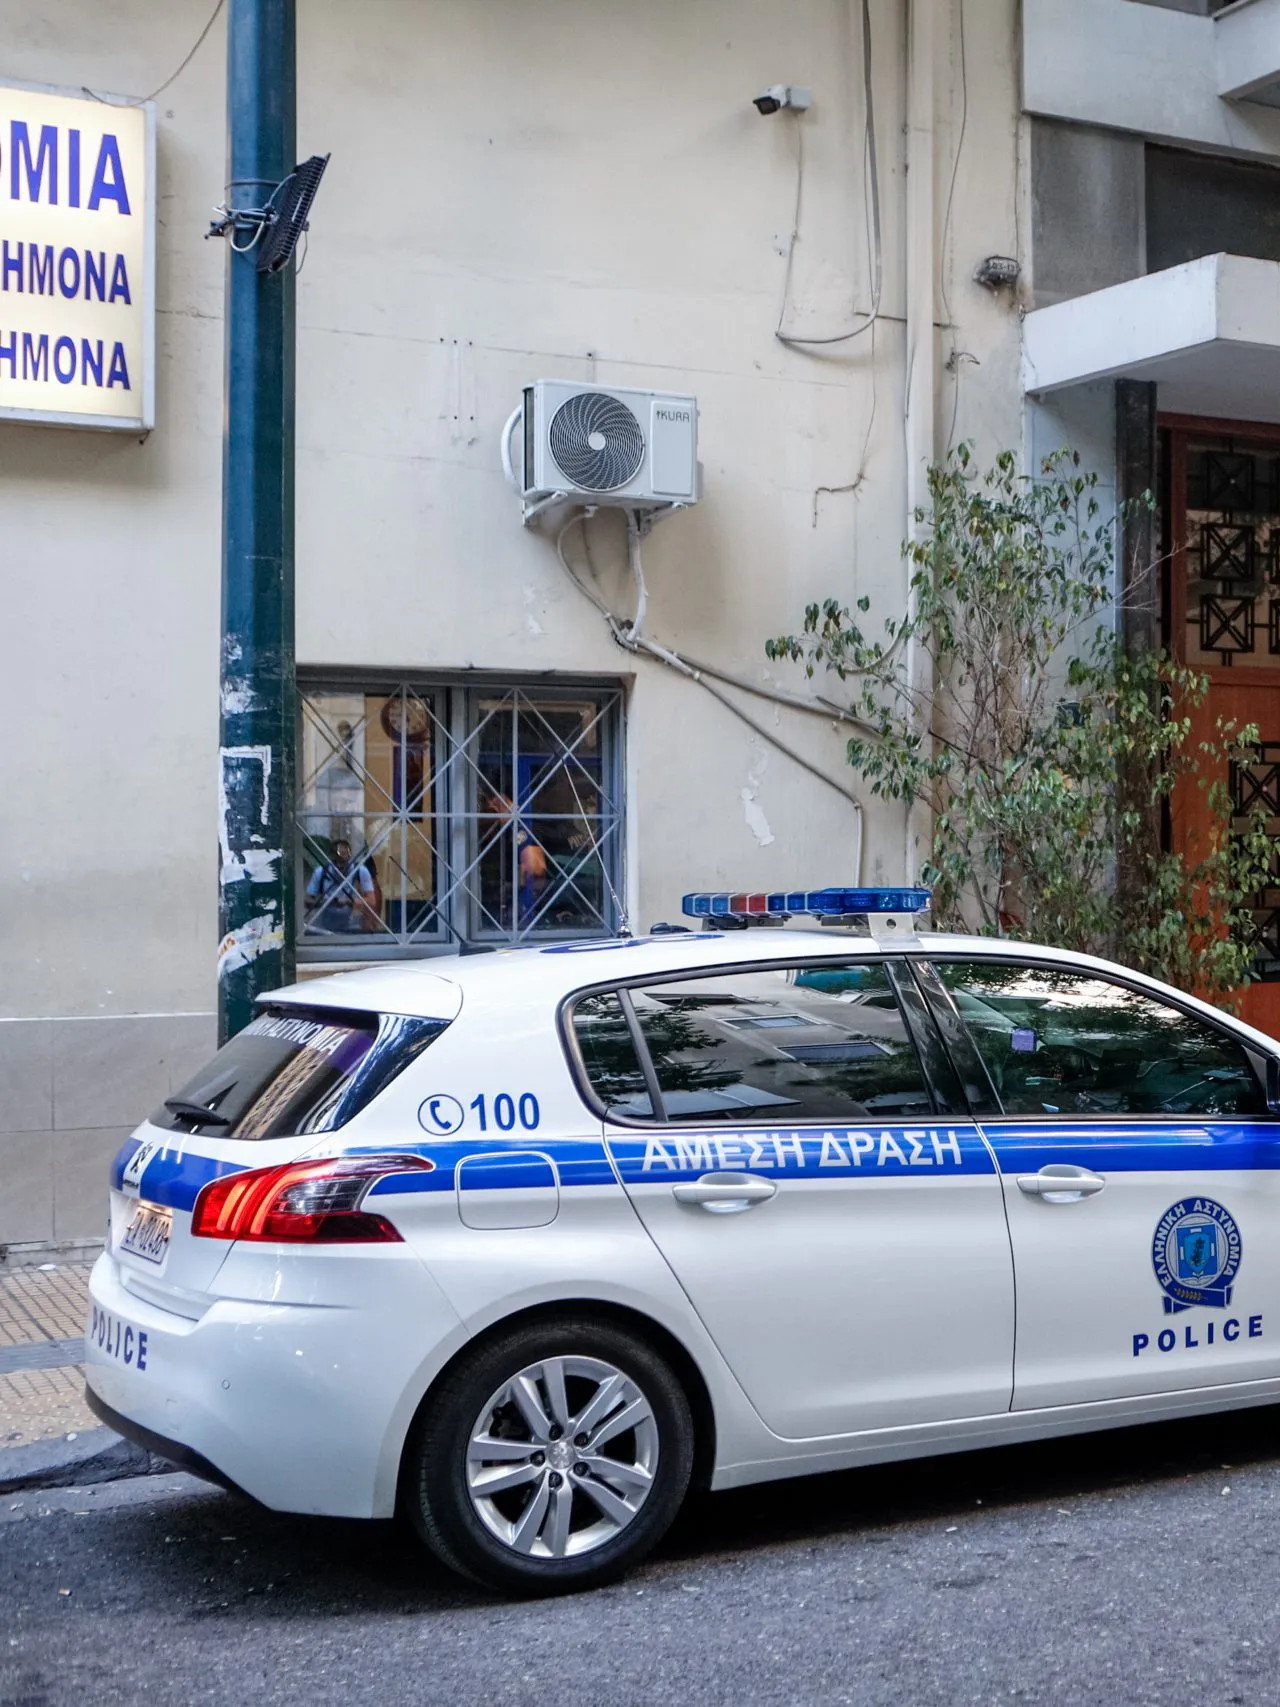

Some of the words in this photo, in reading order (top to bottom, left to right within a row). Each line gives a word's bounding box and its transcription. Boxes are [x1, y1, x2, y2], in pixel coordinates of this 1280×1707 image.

[0, 120, 131, 216] ΜΙΑ
[470, 1092, 540, 1131] 100
[818, 1131, 962, 1167] ΔΡΑΣΗ
[1154, 1203, 1187, 1288] ΕΛΛΗΝΙΚΗ
[1193, 1199, 1240, 1278] ΑΣΤΥΝΟΜΙΑ
[91, 1305, 148, 1371] POLICE
[1132, 1314, 1263, 1357] POLICE
